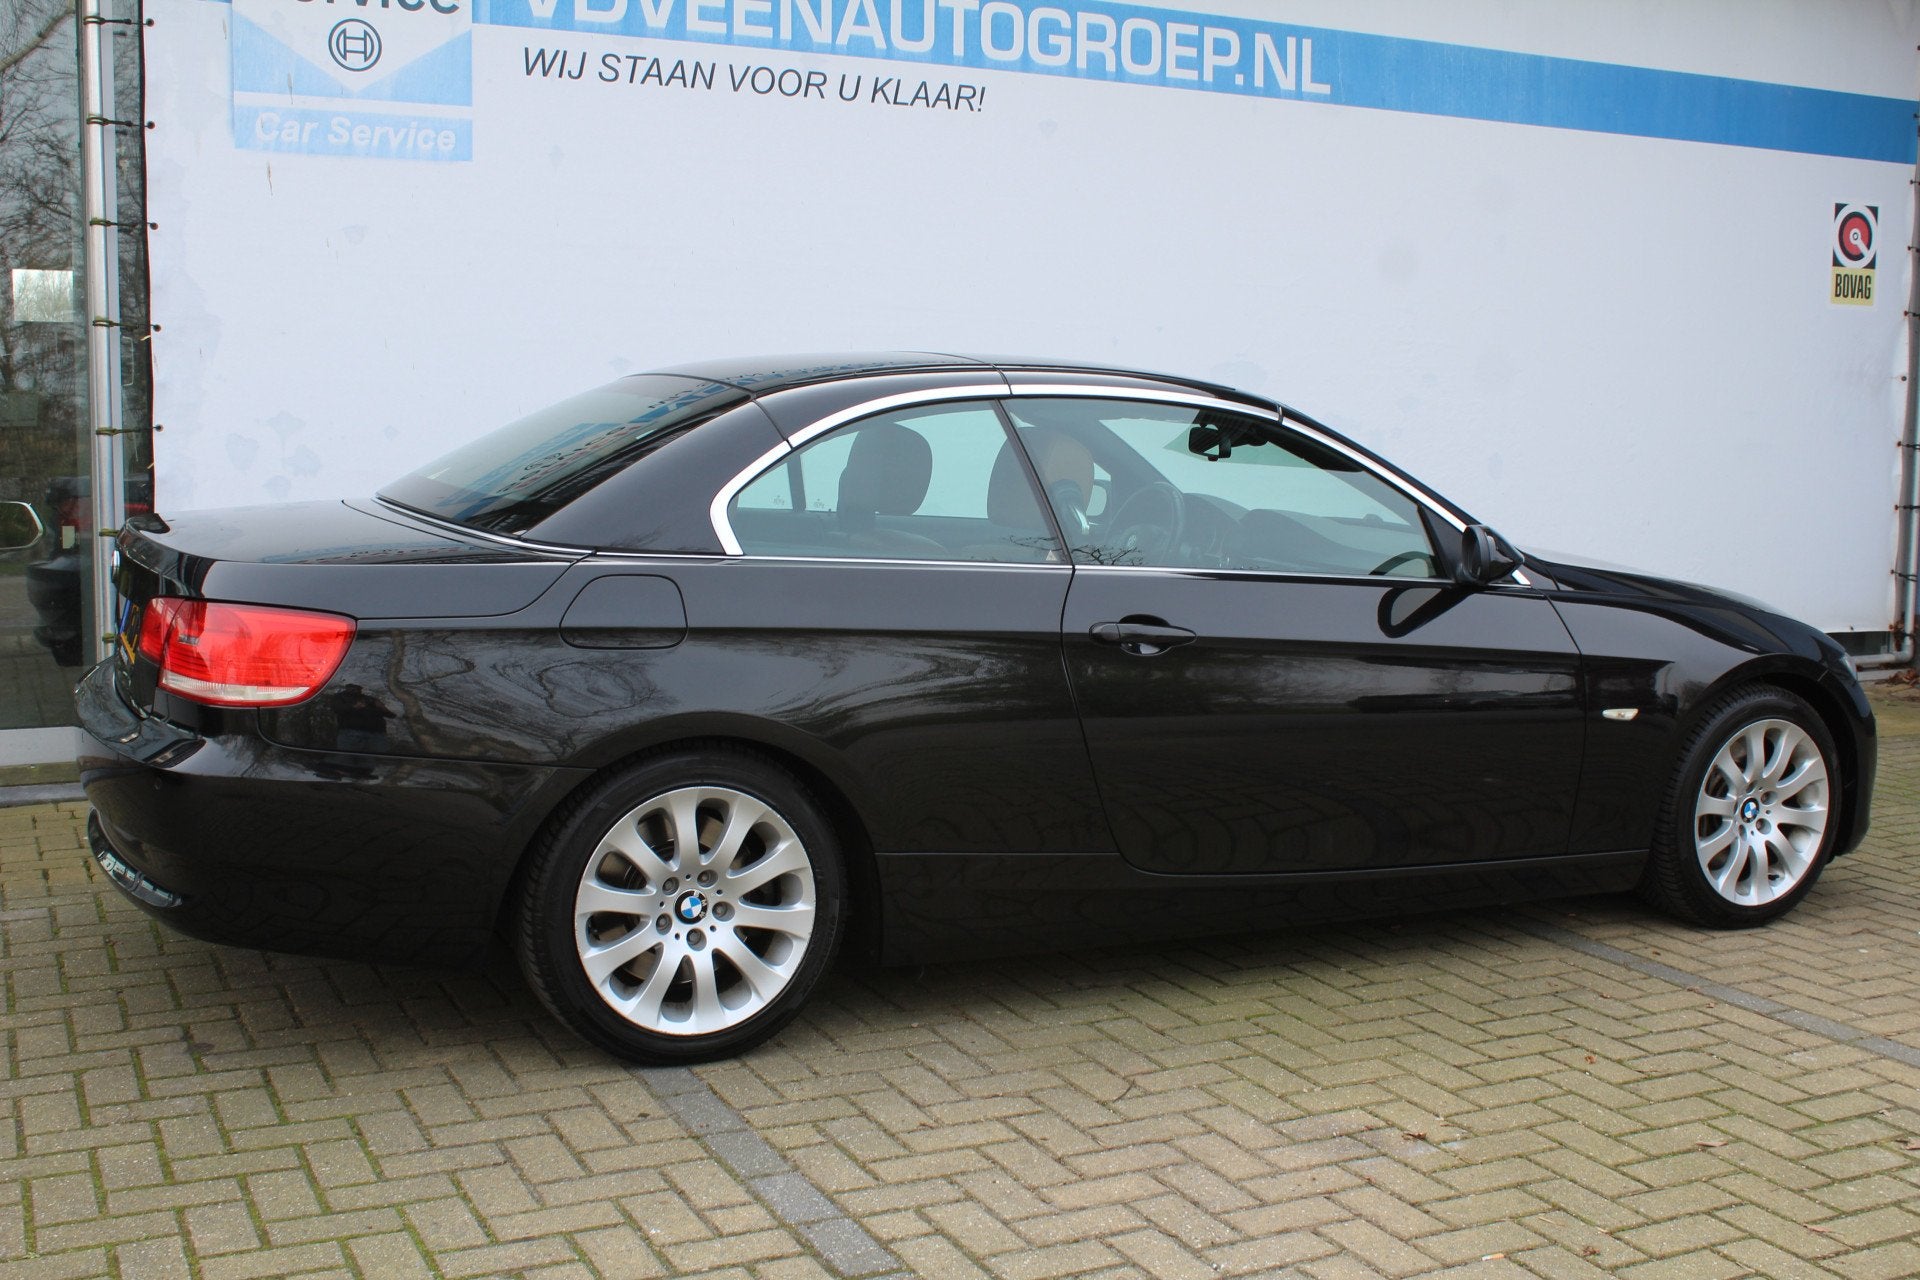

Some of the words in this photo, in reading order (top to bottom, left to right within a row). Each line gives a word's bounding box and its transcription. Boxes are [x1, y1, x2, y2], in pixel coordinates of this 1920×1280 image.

[526, 0, 1331, 95] EENAUTOGROEP.NL
[524, 47, 587, 80] WIJ
[598, 53, 716, 90] STAAN
[729, 63, 828, 100] VOOR
[838, 74, 862, 102] U
[870, 76, 986, 112] KLAAR!
[255, 112, 319, 144] Car
[327, 116, 456, 150] Service
[1834, 273, 1872, 300] BOVAG
